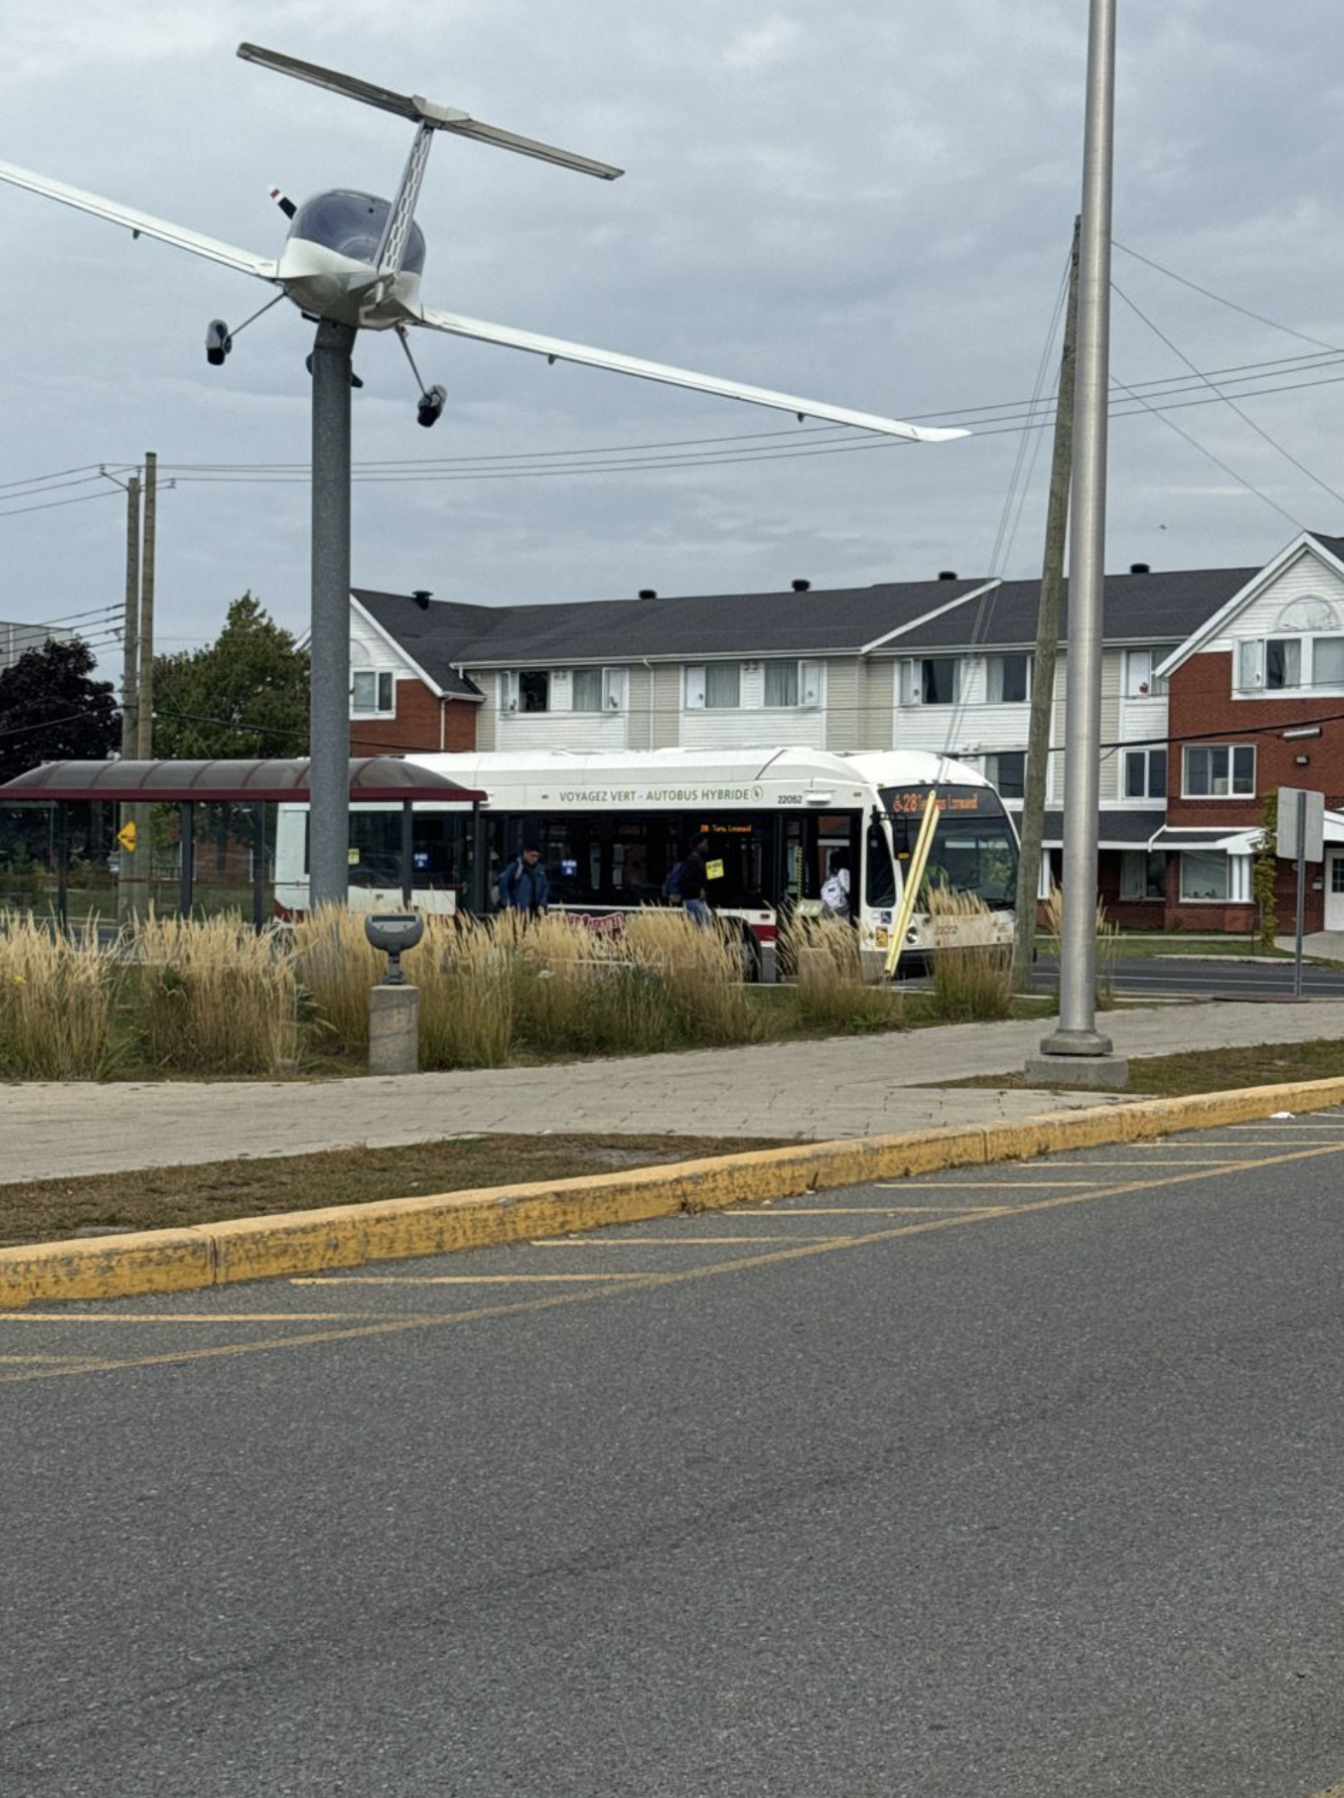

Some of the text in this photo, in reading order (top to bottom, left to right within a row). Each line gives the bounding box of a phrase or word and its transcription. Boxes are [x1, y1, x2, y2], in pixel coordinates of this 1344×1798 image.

[559, 790, 608, 802] VOYAGEZ
[610, 790, 636, 801] VERT
[645, 789, 698, 801] AUTOBUS
[701, 788, 750, 800] HYBRIDE
[777, 794, 803, 804] 22052
[904, 793, 918, 812] 28
